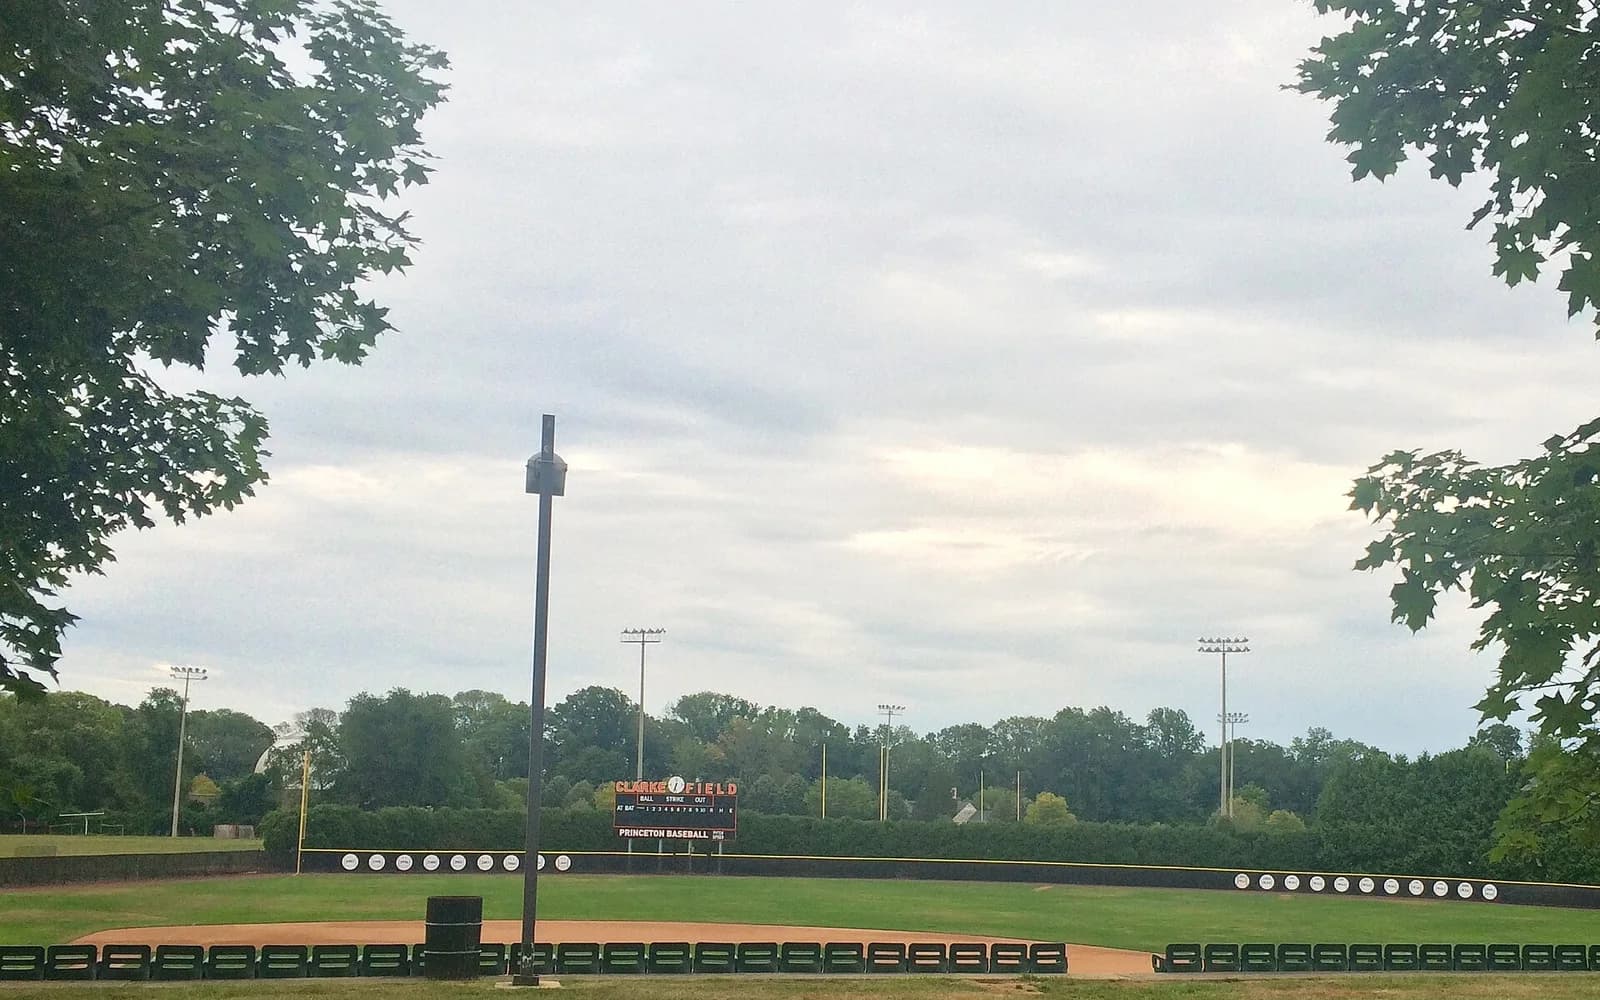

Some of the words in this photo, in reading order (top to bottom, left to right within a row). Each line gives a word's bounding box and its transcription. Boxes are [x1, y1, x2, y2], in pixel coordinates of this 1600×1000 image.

[615, 781, 665, 793] CLARKE
[685, 782, 737, 795] FIELD
[619, 828, 665, 837] PRINCETON
[666, 830, 709, 839] BASEBALL
